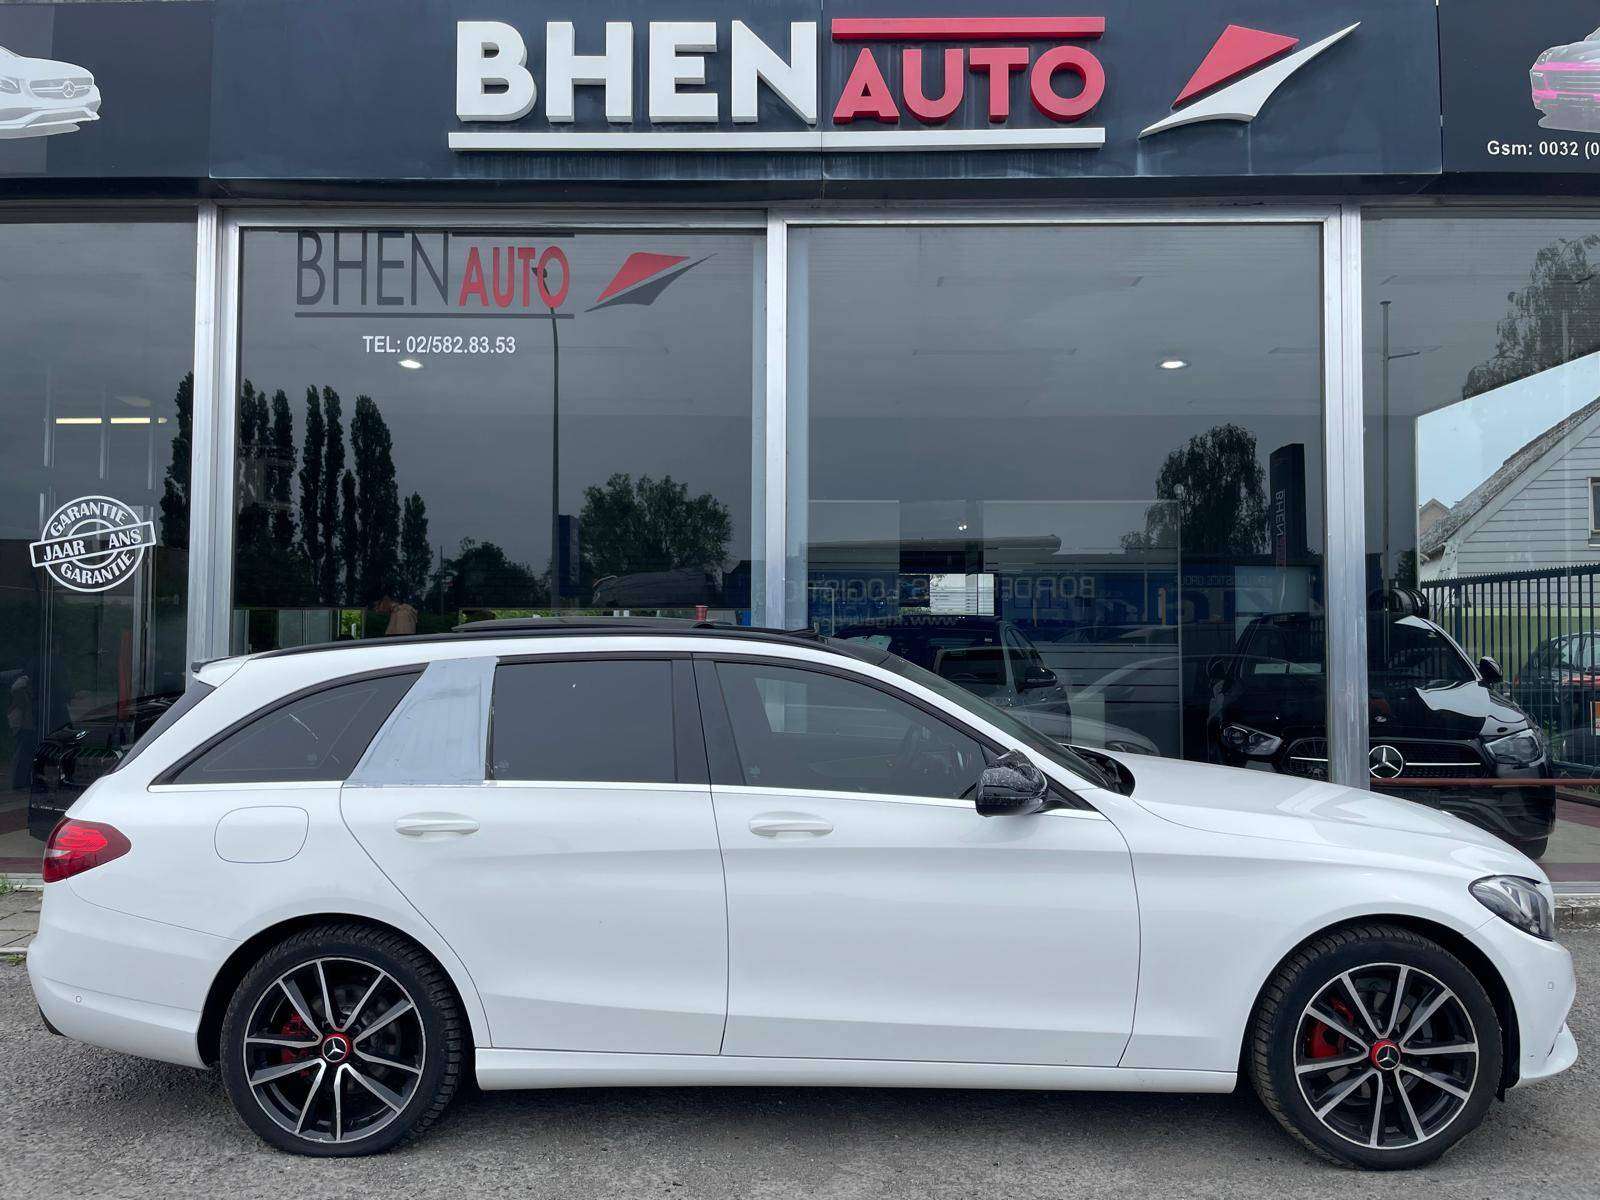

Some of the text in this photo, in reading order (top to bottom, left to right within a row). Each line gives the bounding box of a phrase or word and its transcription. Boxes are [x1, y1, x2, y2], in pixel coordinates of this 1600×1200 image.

[456, 20, 1106, 125] BHEN AUTO
[1487, 140, 1533, 156] Gsm:
[1539, 141, 1579, 156] 0032
[362, 335, 517, 354] TEL: 02/582.83.53
[50, 501, 128, 537] GARANTIE
[44, 528, 142, 562] JAAR ANS
[60, 552, 135, 585] GARANTIE
